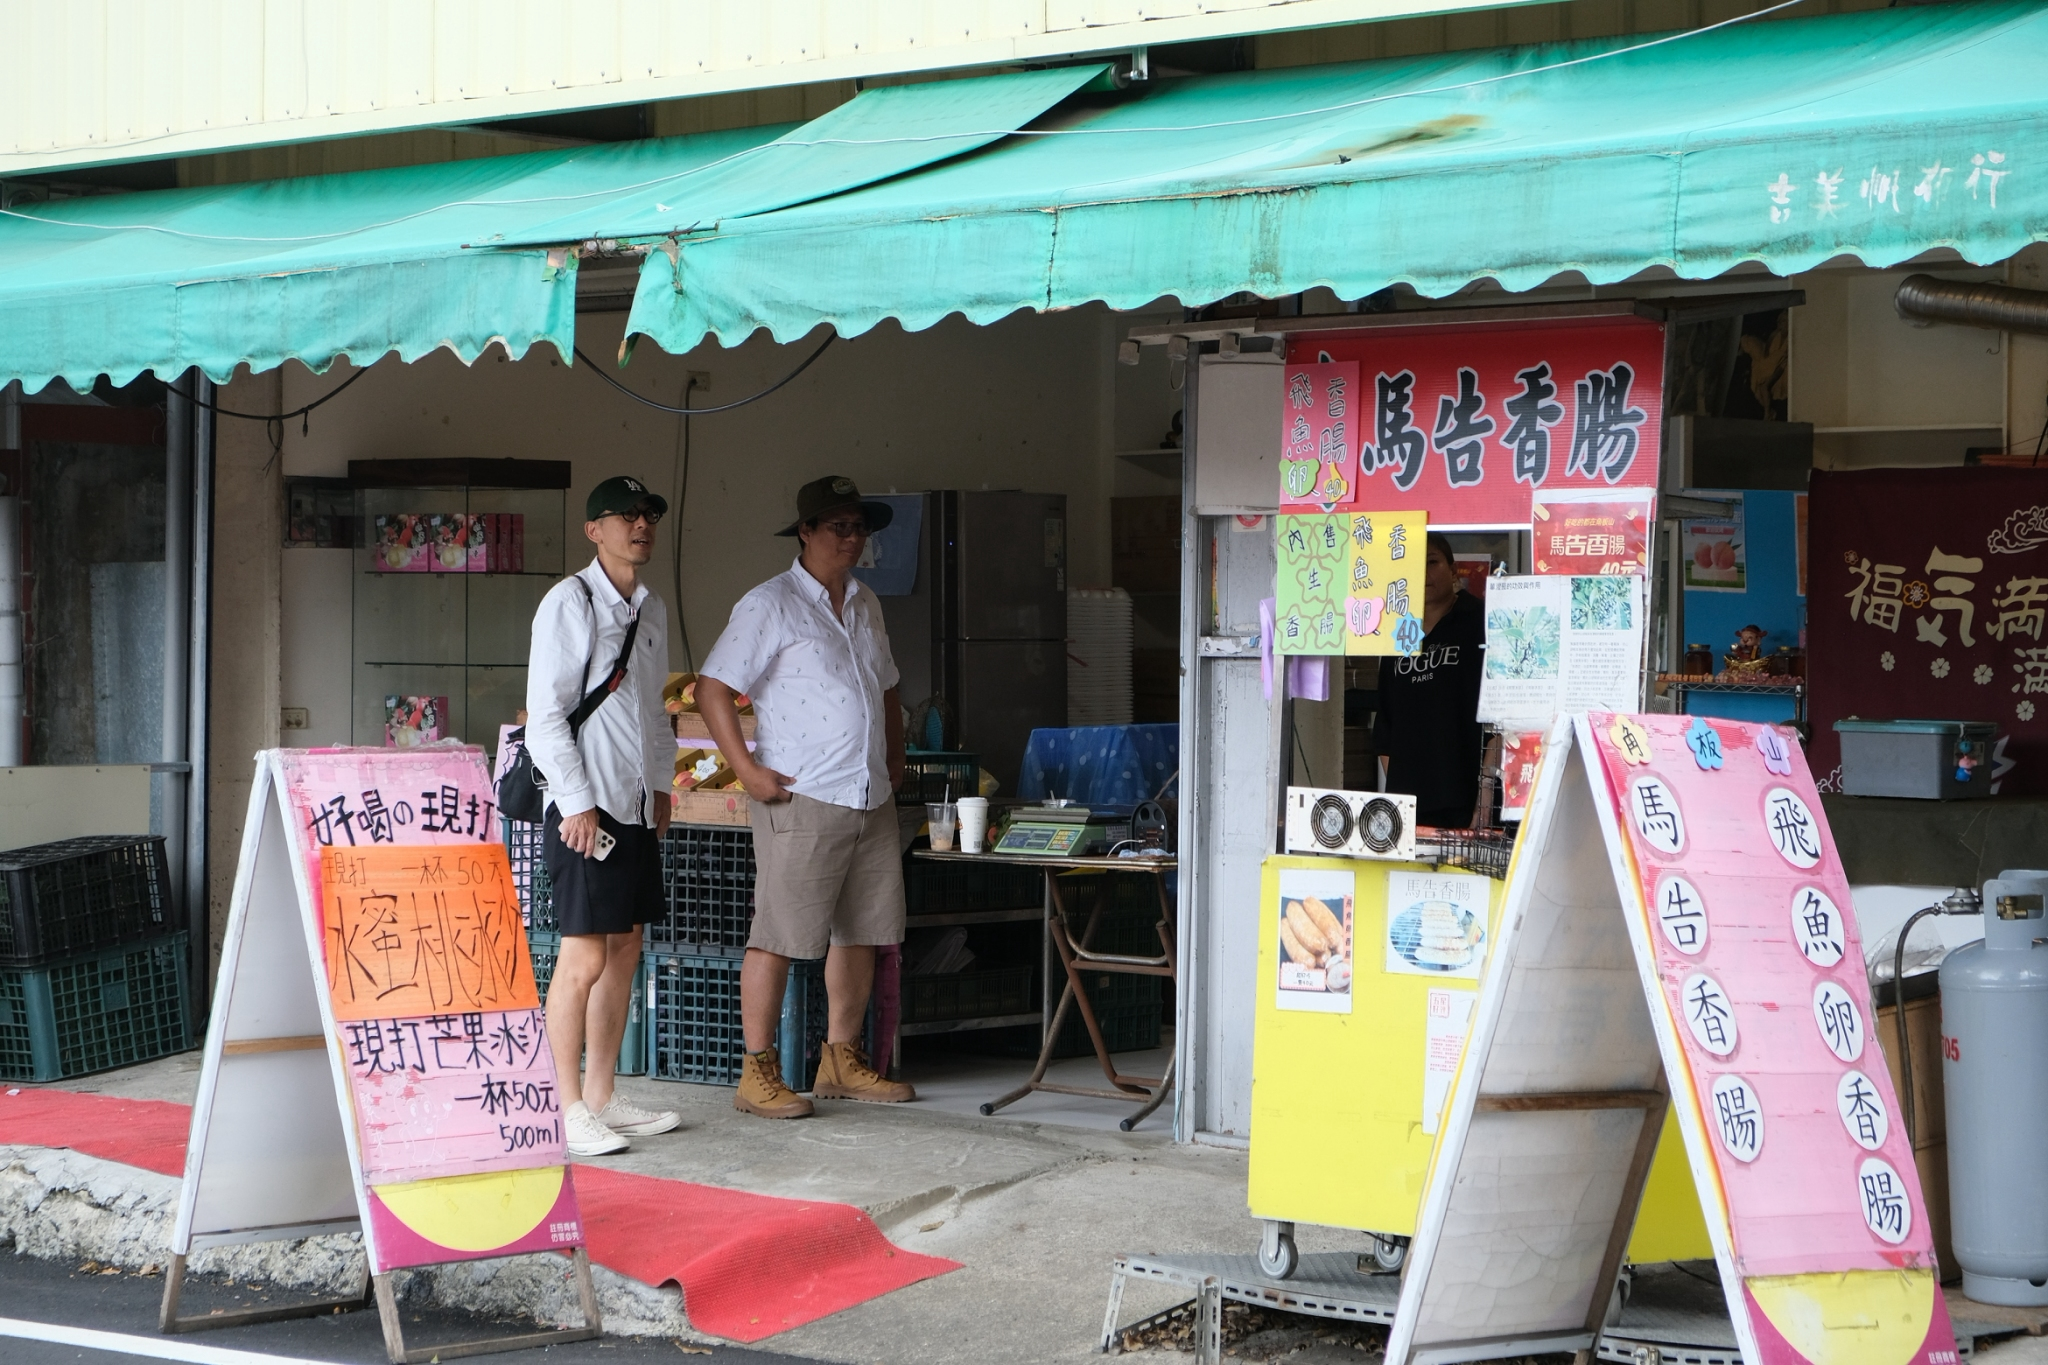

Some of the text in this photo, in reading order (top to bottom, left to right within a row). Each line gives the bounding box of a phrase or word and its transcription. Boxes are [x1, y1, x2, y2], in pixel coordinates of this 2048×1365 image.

[1320, 376, 1347, 464] 香腸
[1361, 361, 1648, 492] 馬告香腸
[624, 479, 642, 491] LA
[1325, 479, 1341, 497] 40
[1550, 534, 1625, 556] 馬告香腸
[1308, 567, 1321, 590] 生
[1386, 524, 1409, 616] 香腸
[1600, 560, 1637, 575] 40元
[1397, 619, 1419, 652] 40
[1411, 673, 1433, 683] PARIS
[307, 785, 494, 846] 好喝の現打
[321, 852, 366, 887] 現打
[1405, 879, 1471, 901] 馬告香腸
[327, 882, 522, 1010] 水蜜桃冰沙
[1637, 784, 1758, 1156] 馬告香腸
[1773, 797, 1905, 1243] 飛魚卵香腸
[346, 1010, 544, 1077] 現打芒果冰沙
[1942, 1035, 1960, 1062] 05
[454, 1074, 559, 1117] 一杯50元
[500, 1119, 560, 1153] 500ml
